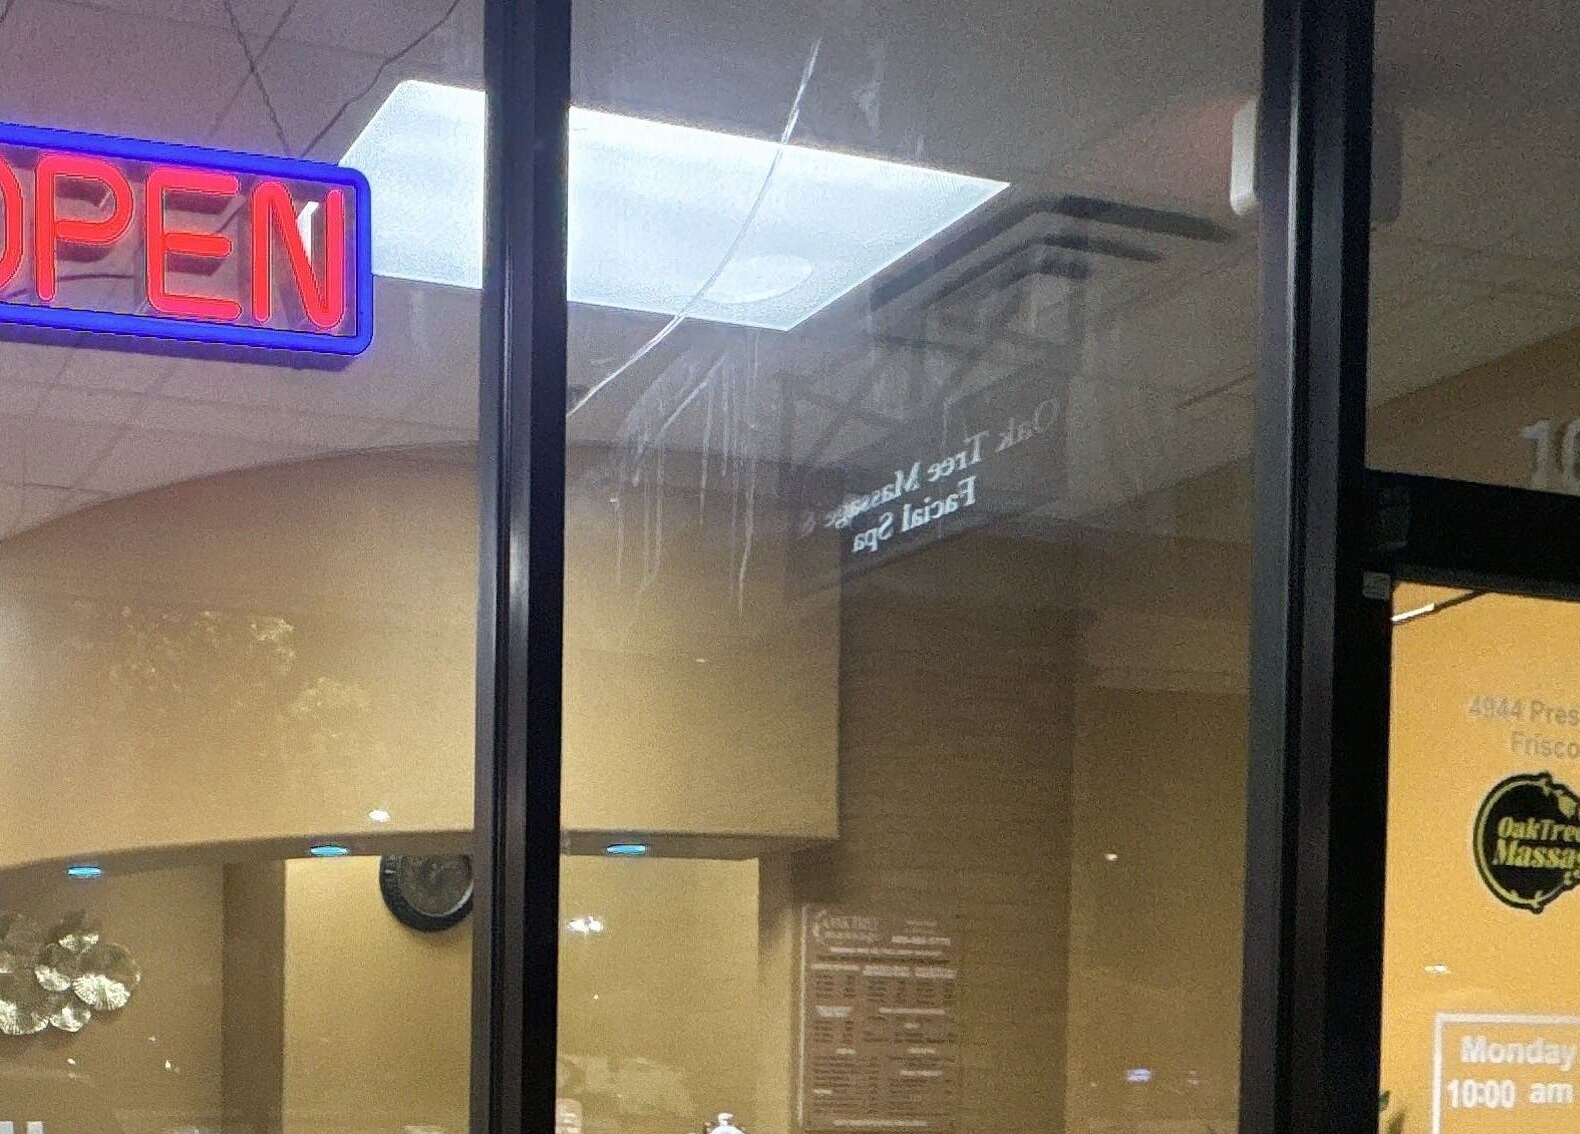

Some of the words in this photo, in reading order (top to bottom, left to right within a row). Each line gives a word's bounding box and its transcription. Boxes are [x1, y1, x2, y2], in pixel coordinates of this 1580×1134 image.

[1492, 838, 1580, 869] Massa
[1461, 1035, 1577, 1072] Monday
[1447, 1079, 1516, 1109] 10:00
[1529, 1082, 1574, 1104] am
